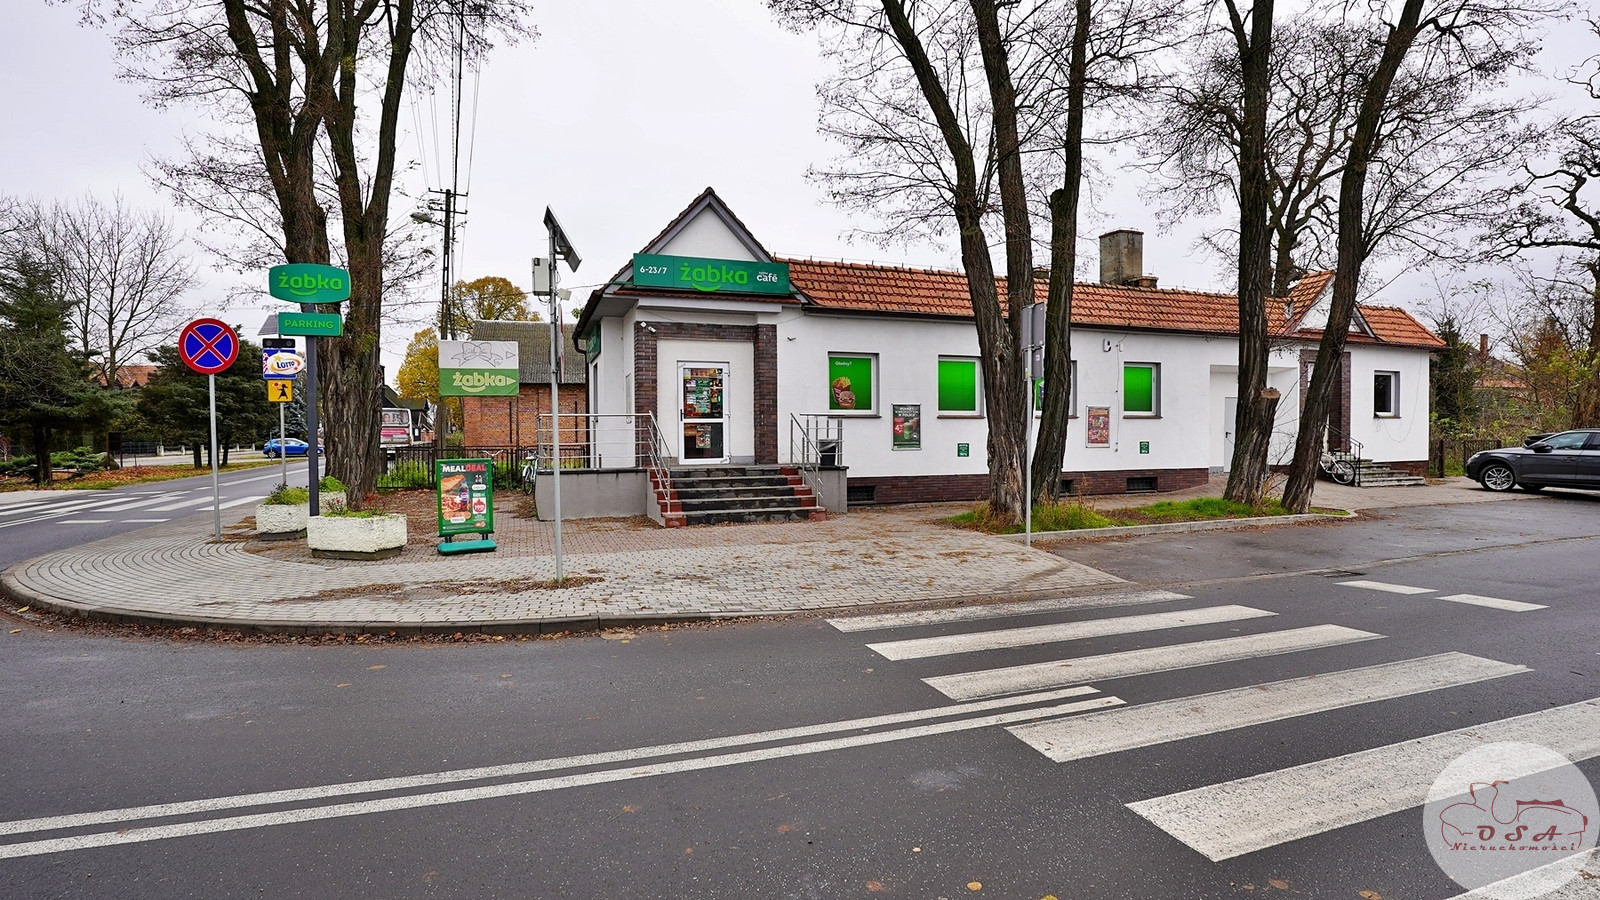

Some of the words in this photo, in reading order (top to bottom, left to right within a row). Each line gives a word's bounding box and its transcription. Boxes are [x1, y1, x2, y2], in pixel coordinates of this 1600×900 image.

[639, 265, 667, 275] 6-23/7
[680, 262, 748, 284] żabka
[278, 272, 342, 291] żabka
[284, 319, 334, 329] PARKING
[452, 371, 506, 387] żabka
